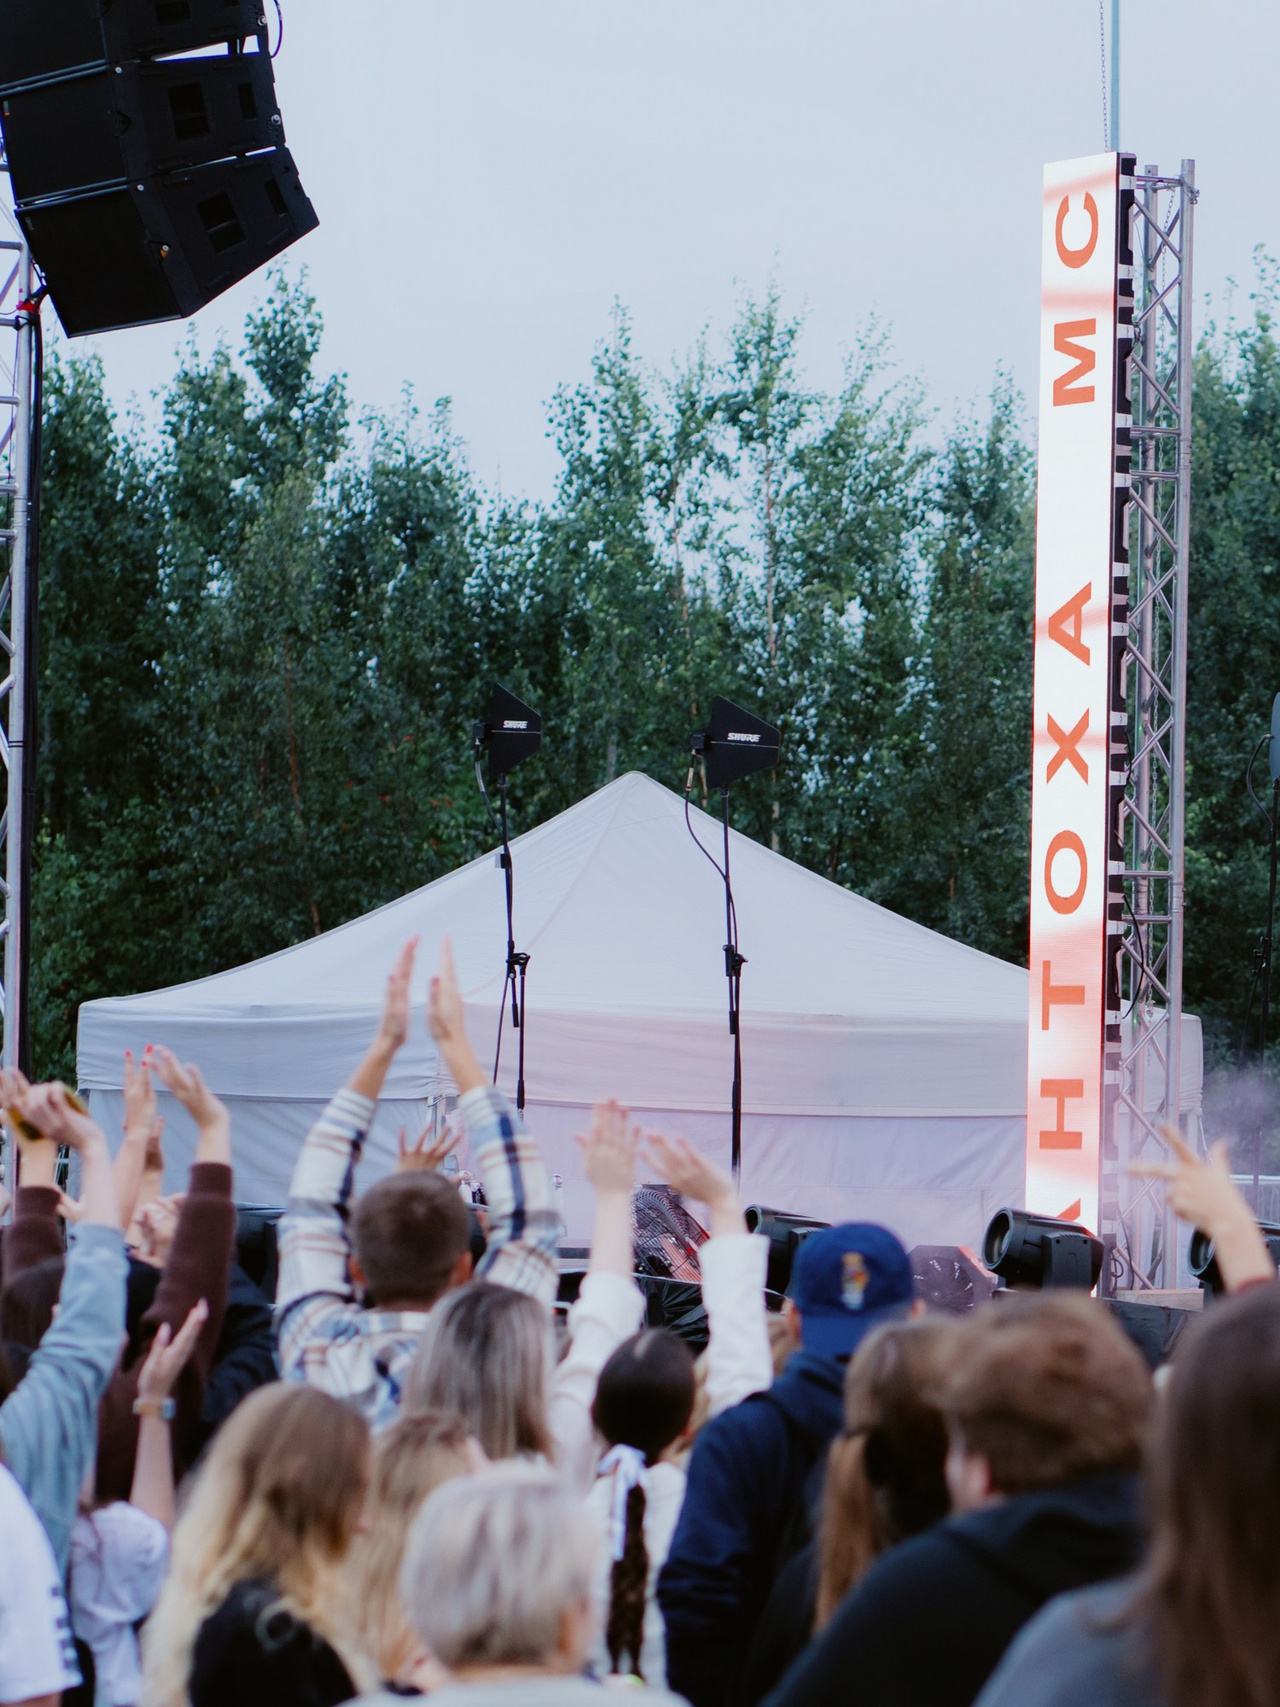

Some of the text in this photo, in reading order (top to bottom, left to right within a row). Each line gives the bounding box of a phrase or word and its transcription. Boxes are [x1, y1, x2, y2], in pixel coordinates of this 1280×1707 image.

[503, 720, 528, 729] SHURE
[727, 732, 761, 743] SHURE
[1040, 583, 1092, 1222] НТОХА
